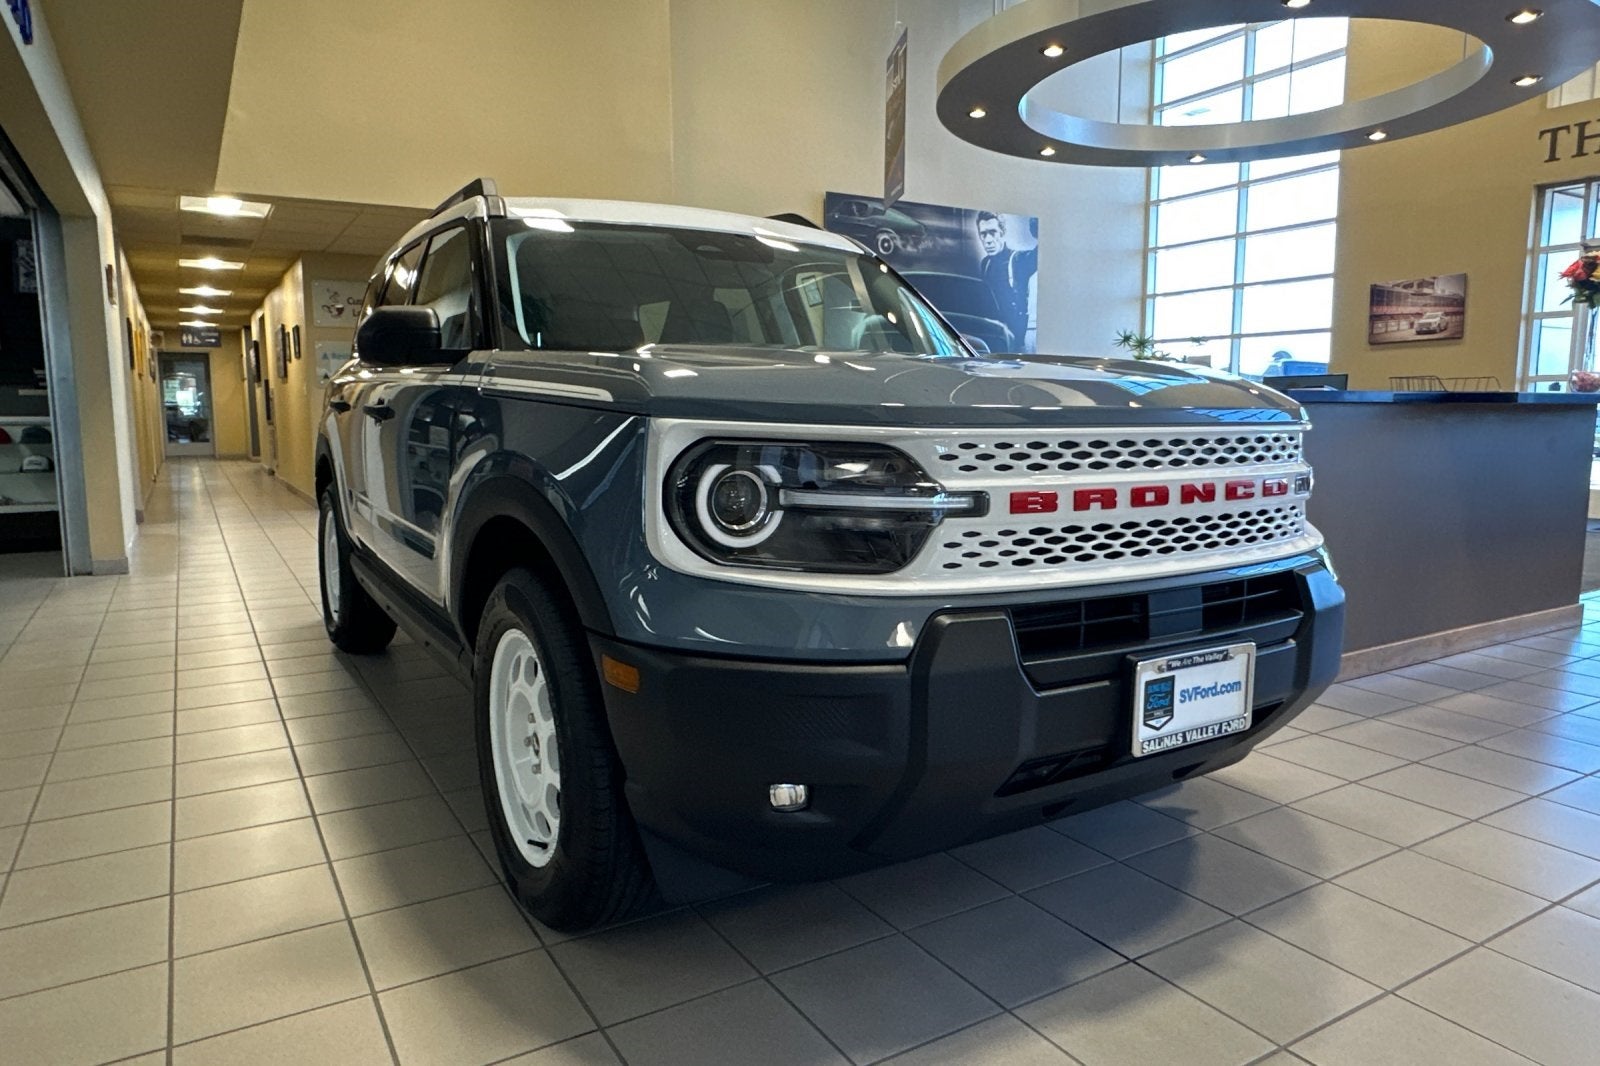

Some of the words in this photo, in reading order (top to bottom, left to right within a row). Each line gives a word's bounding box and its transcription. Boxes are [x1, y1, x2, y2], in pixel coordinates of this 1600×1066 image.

[1009, 478, 1289, 515] BRONCO
[1193, 656, 1204, 664] The
[1146, 694, 1171, 709] Ford
[1179, 681, 1241, 703] SVFord.com
[1142, 733, 1183, 754] SALINAS
[1185, 723, 1221, 742] VALLEY
[1221, 719, 1245, 736] FORD
